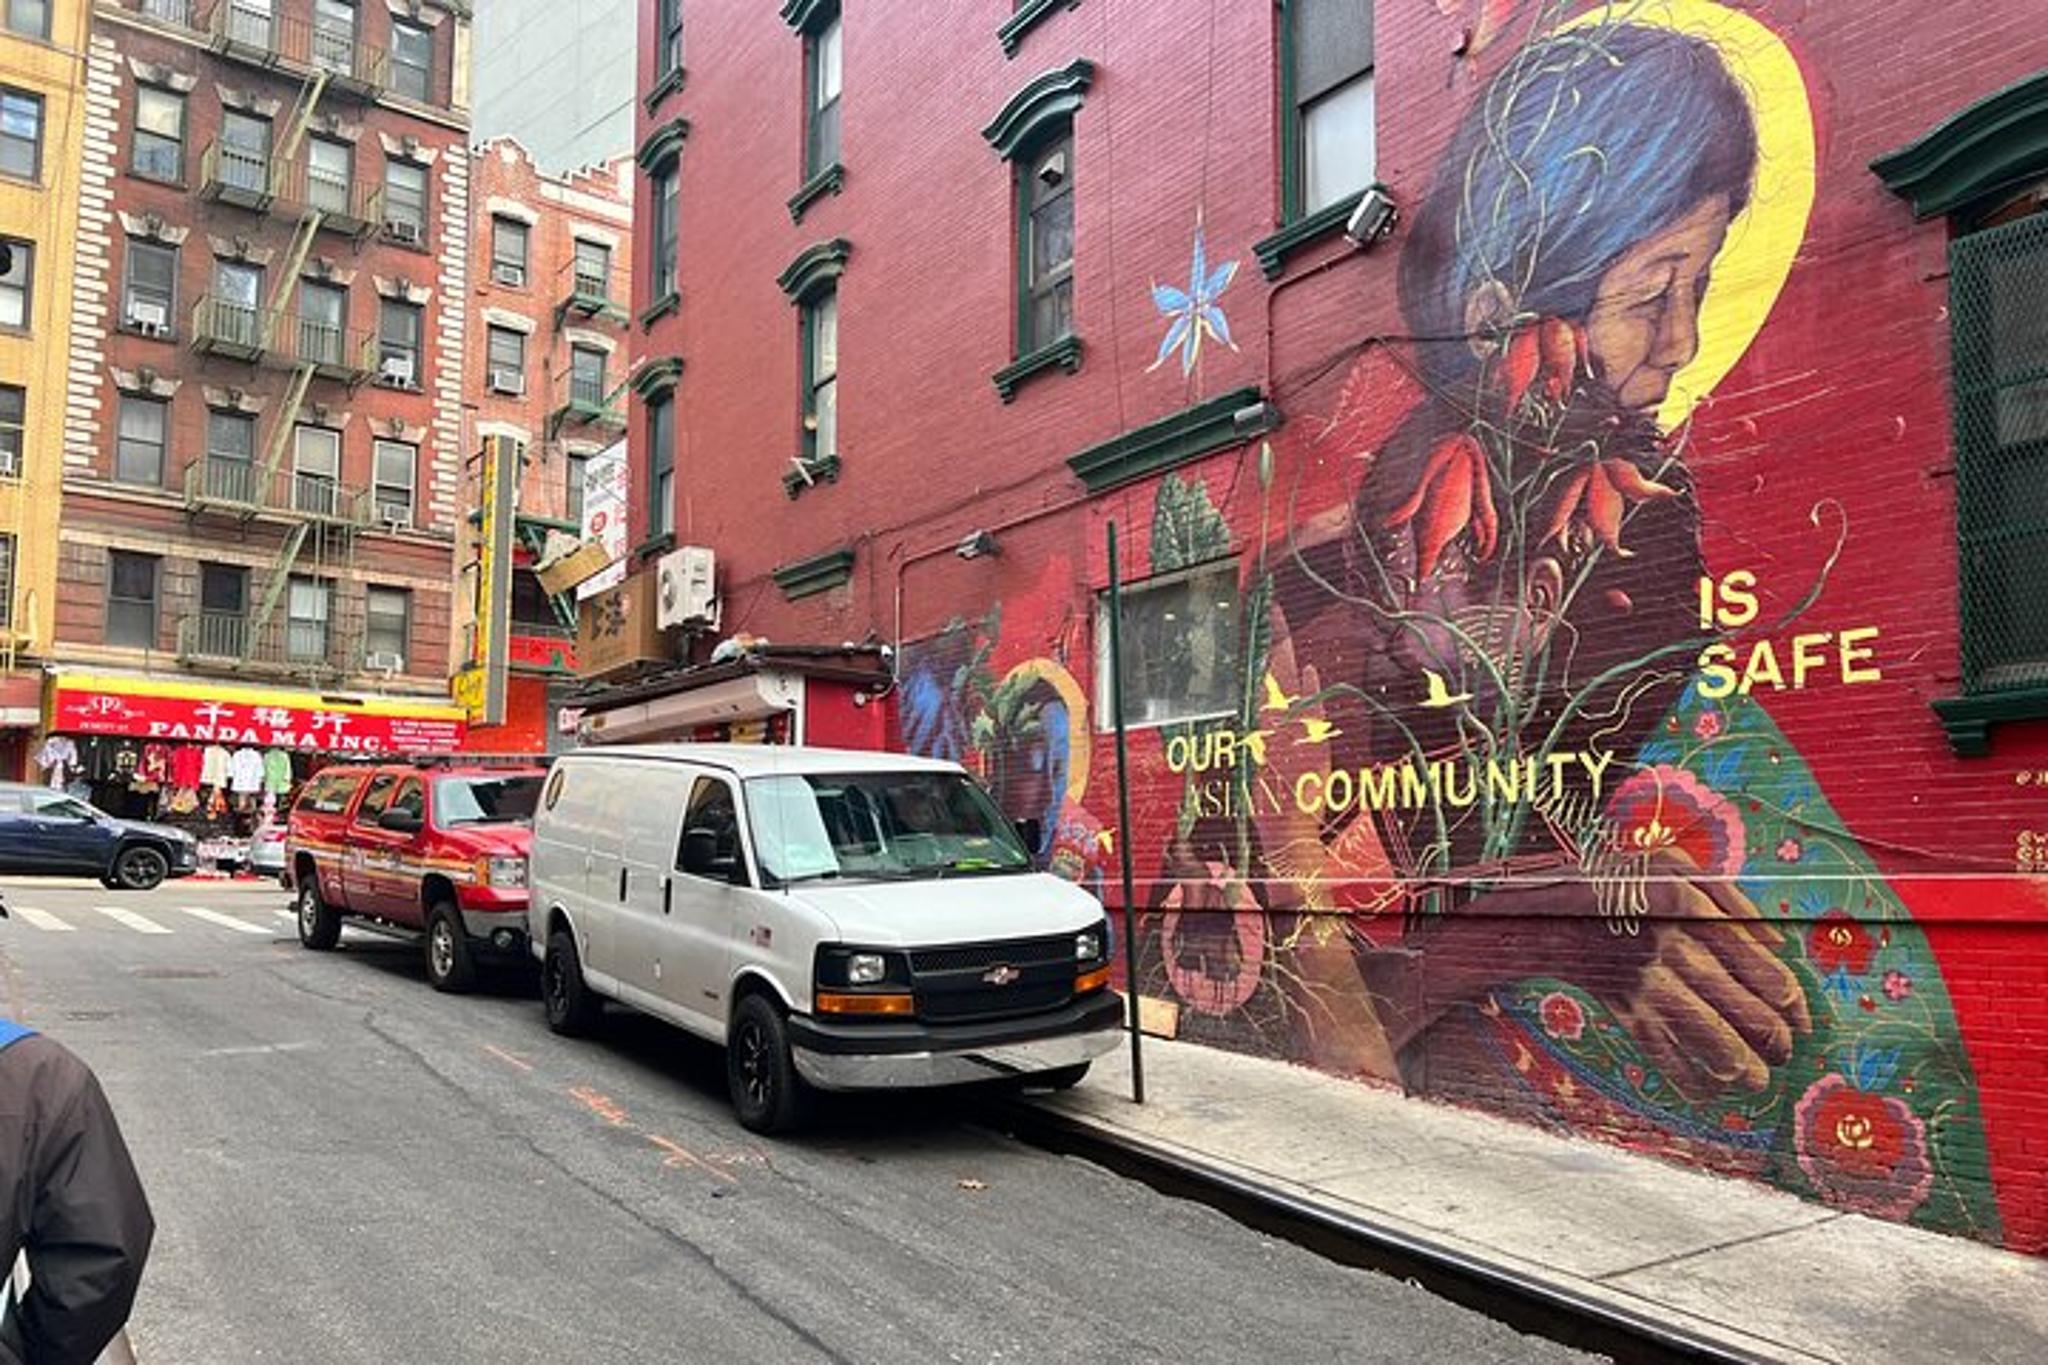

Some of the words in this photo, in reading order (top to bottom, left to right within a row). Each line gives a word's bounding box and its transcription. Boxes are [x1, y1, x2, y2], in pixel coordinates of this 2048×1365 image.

[1699, 570, 1760, 630] IS
[1697, 627, 1882, 699] SAFE
[149, 721, 260, 744] PANDA
[271, 729, 318, 748] MA
[329, 735, 388, 752] INC.
[1167, 730, 1236, 772] OUR
[1177, 774, 1284, 818] ASIAN
[1295, 750, 1614, 813] COMMUNITY
